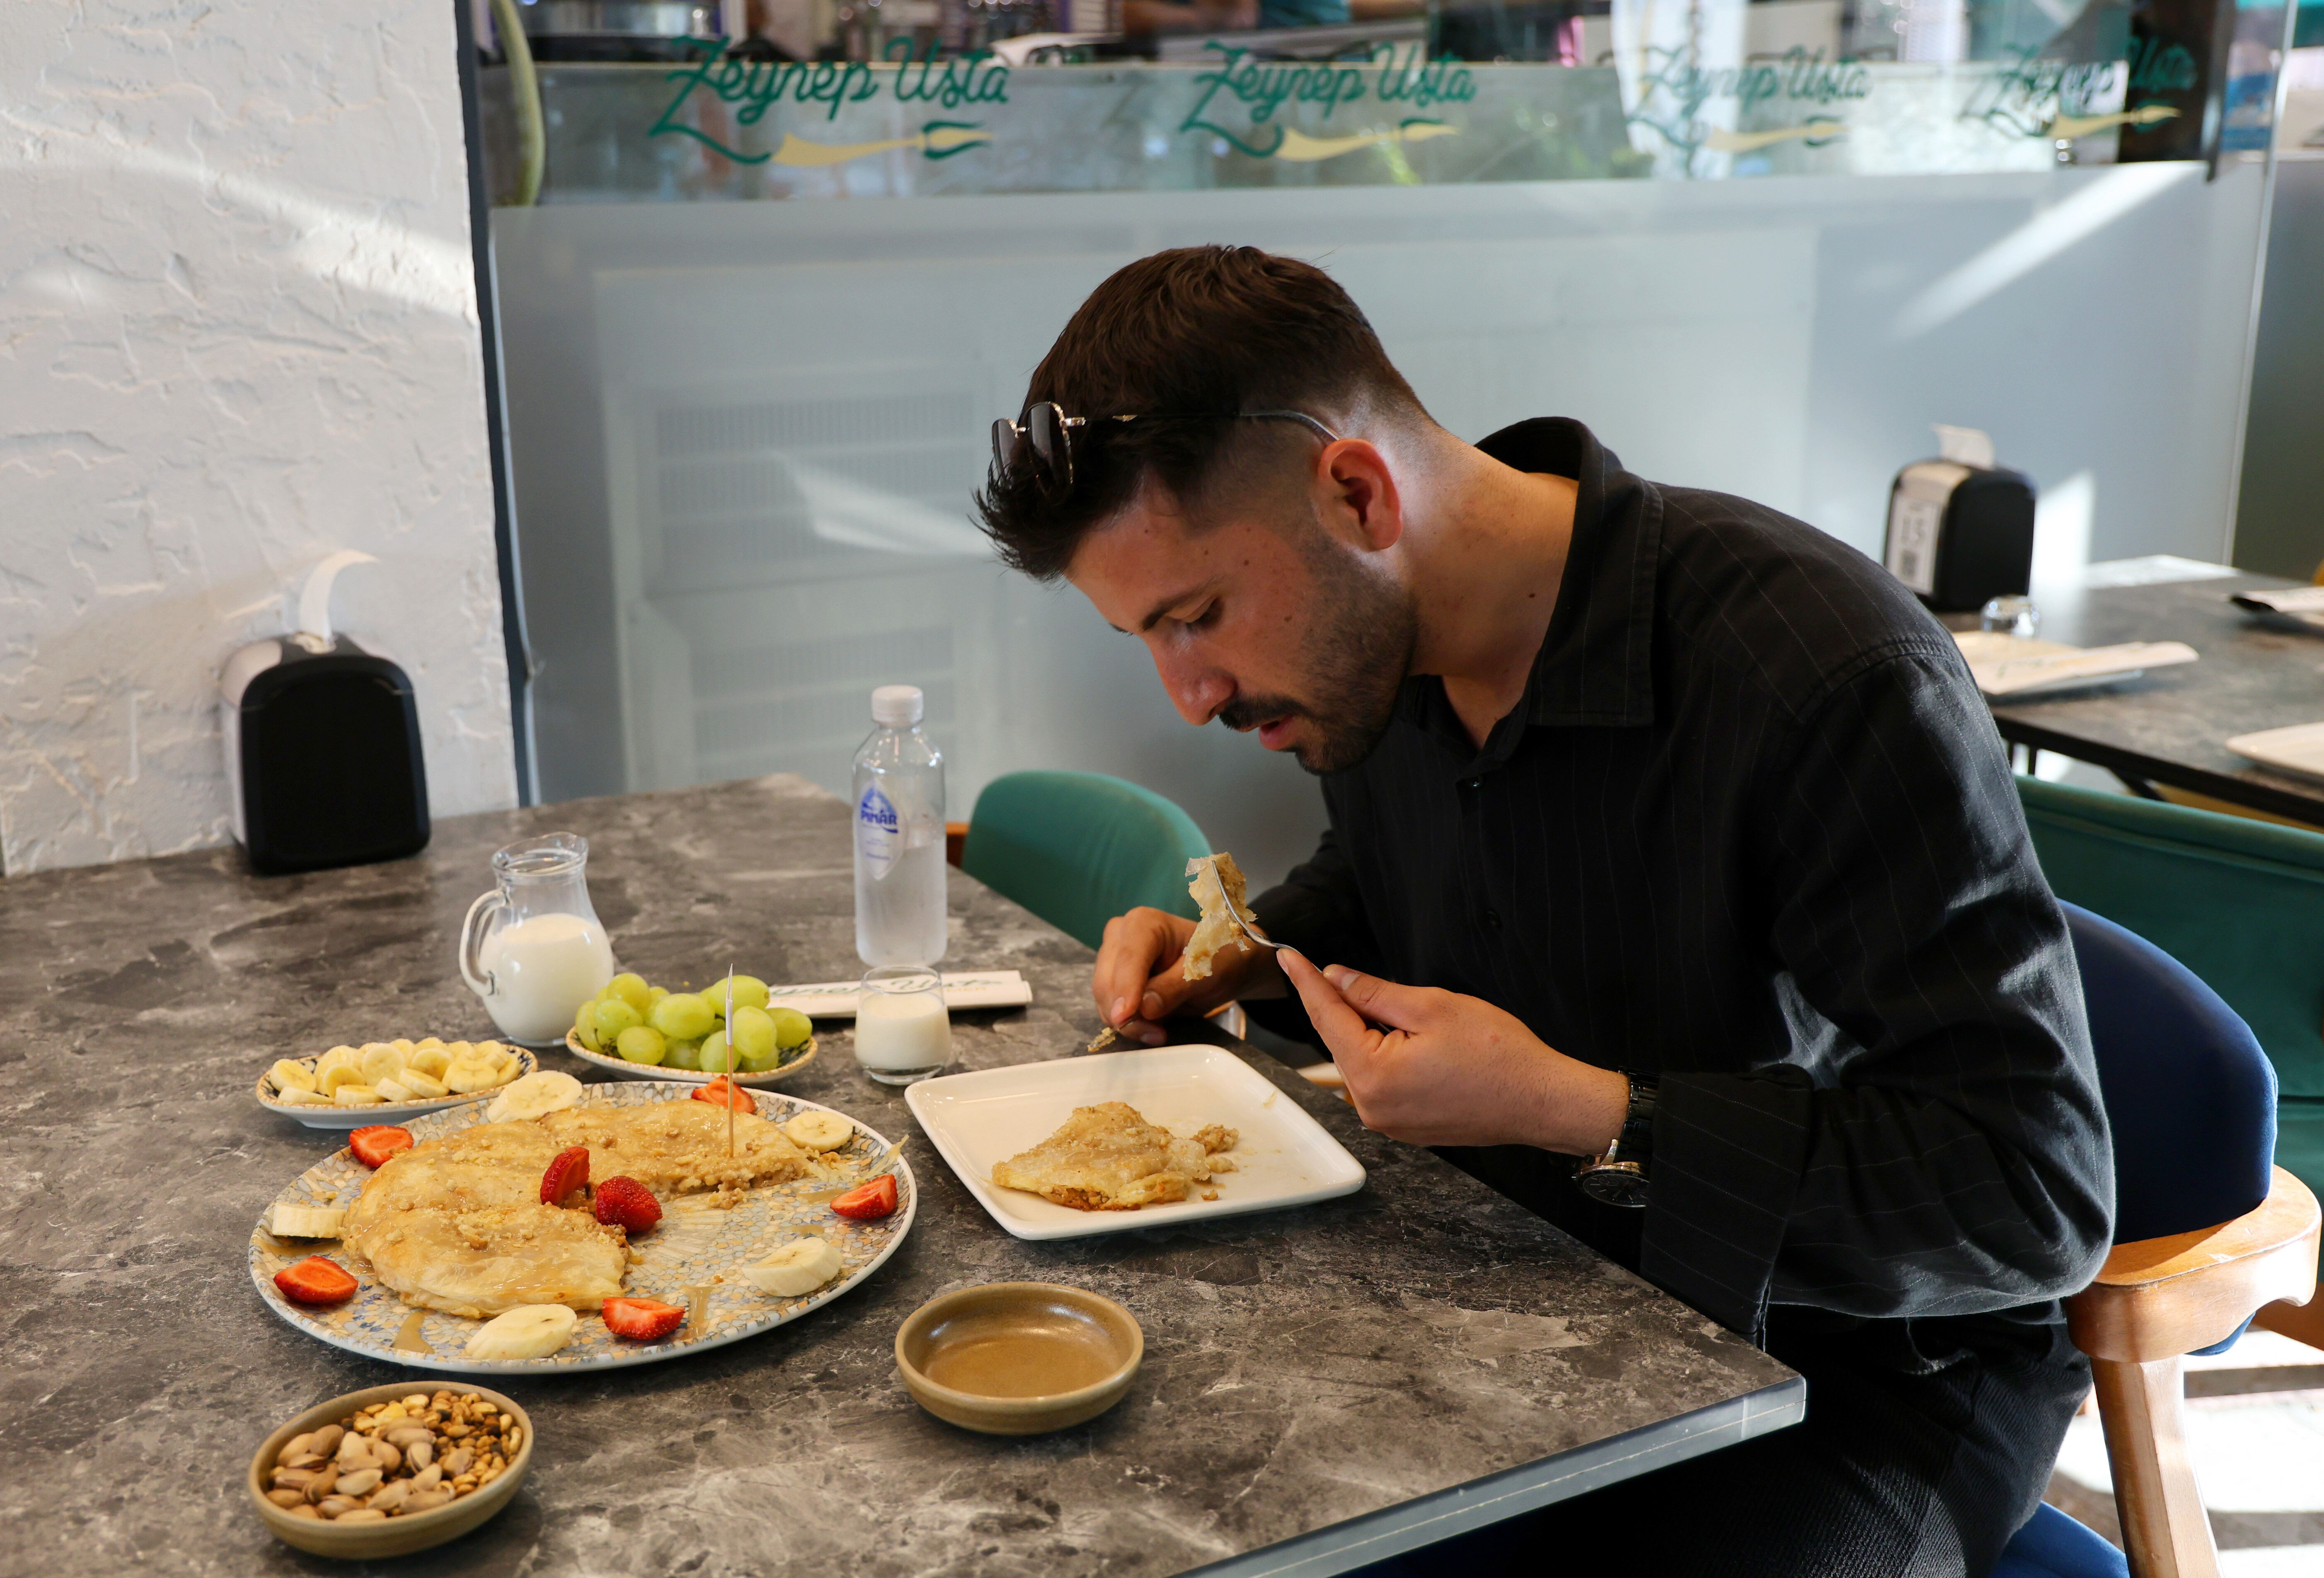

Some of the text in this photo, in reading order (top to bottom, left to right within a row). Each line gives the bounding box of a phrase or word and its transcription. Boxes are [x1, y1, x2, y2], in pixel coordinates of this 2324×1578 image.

[648, 35, 1009, 165] Zeynep Usta
[1179, 39, 1477, 158] Zeynep Usta
